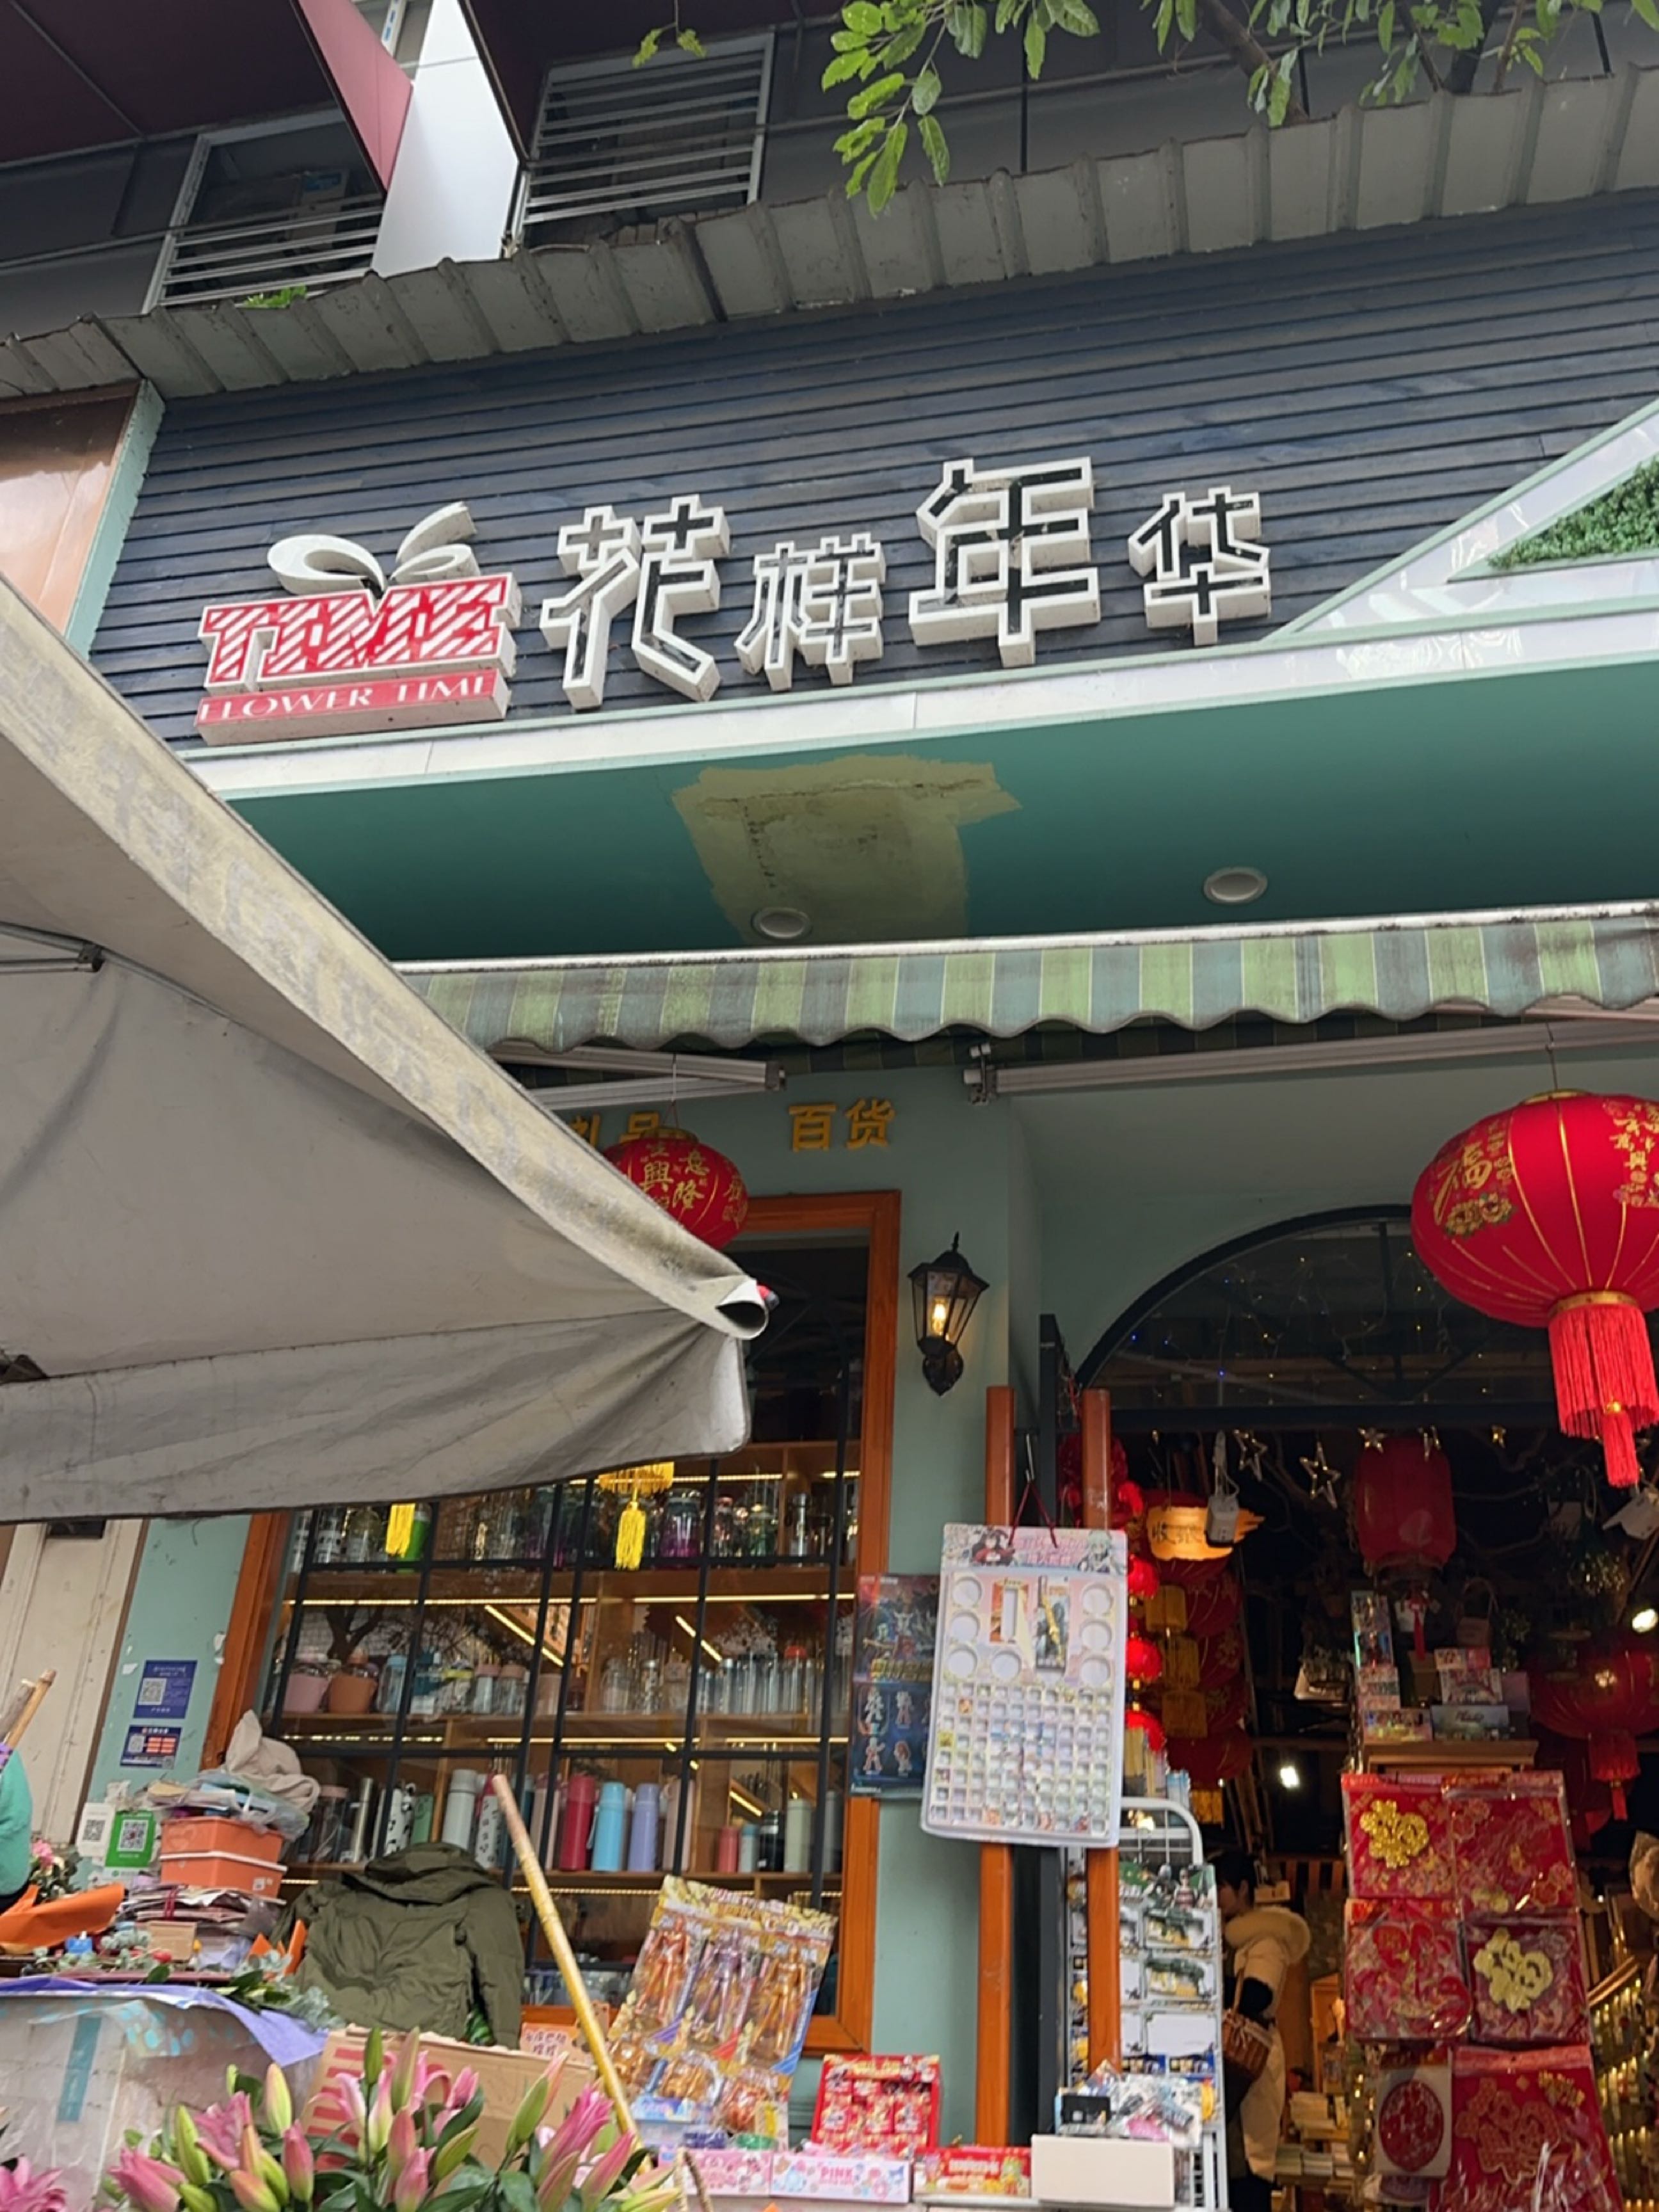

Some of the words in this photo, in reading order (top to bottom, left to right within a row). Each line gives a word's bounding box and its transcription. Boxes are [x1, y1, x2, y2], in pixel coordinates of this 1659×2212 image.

[198, 572, 514, 689] TIME
[540, 457, 1270, 708] 花样年华
[789, 1098, 895, 1153] 百货
